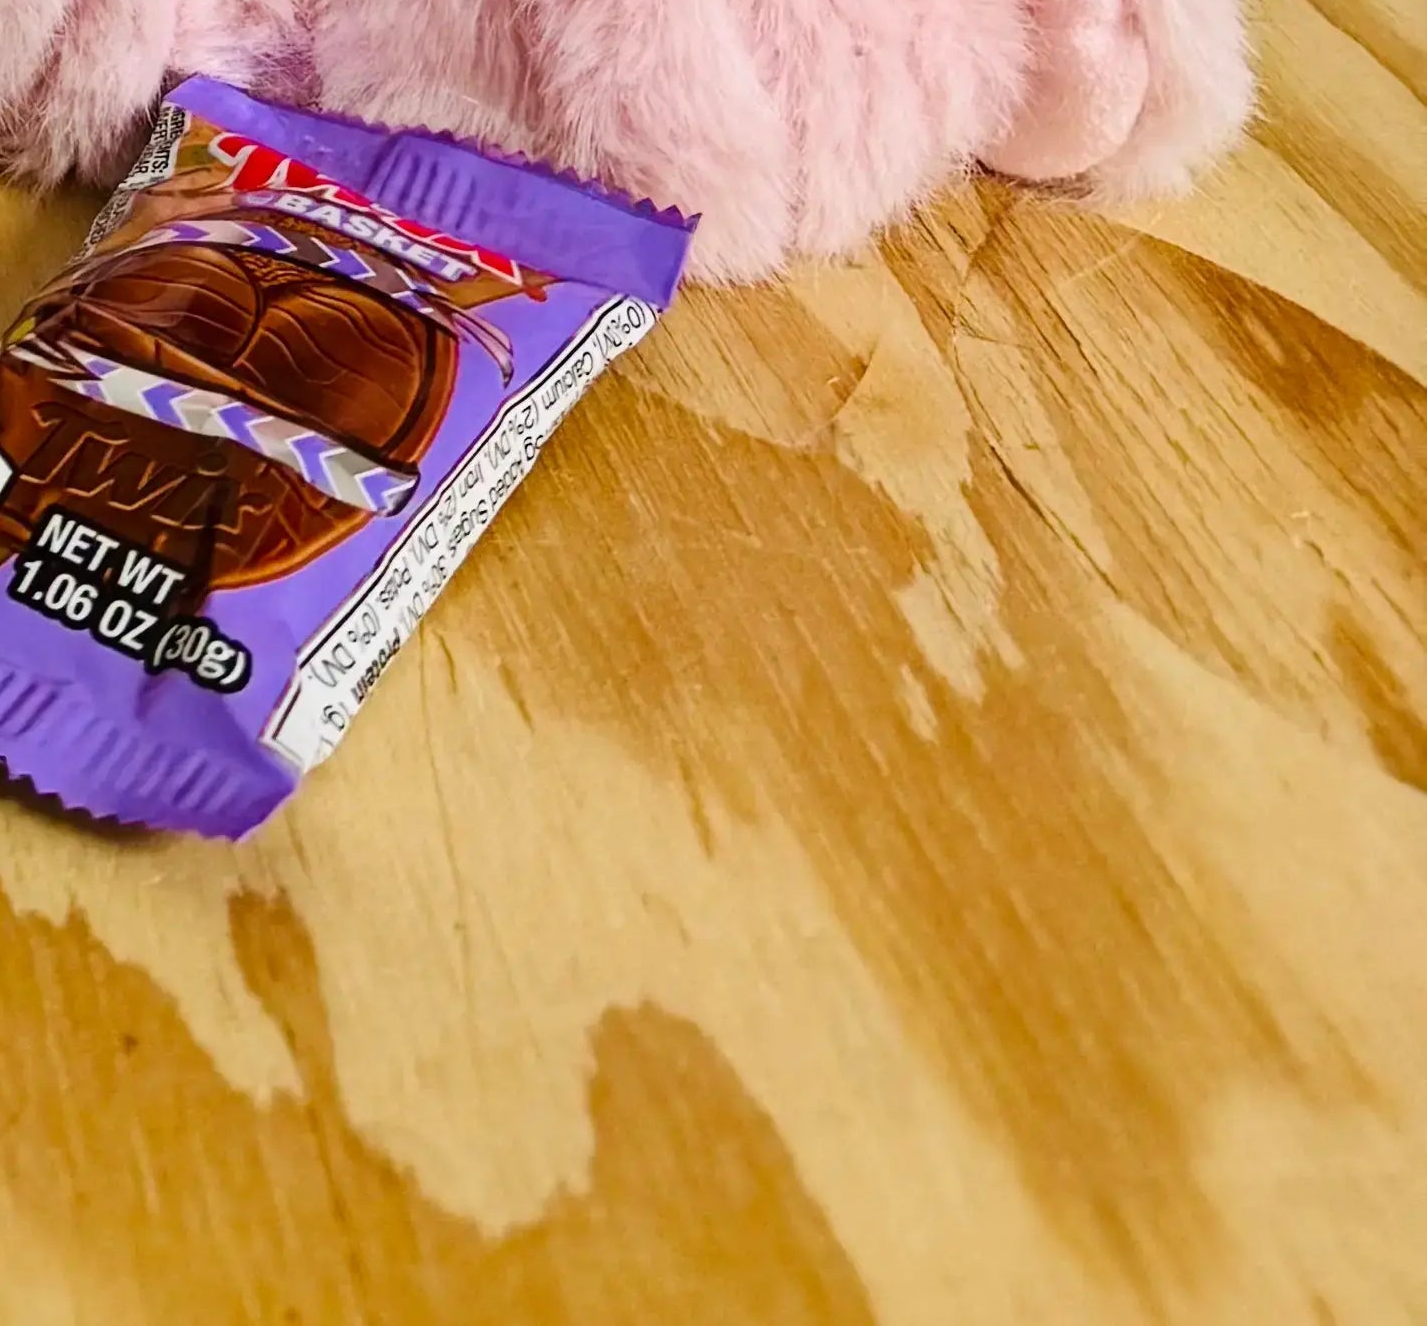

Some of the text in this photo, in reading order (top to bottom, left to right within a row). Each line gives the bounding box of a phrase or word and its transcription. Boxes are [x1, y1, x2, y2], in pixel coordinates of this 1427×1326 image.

[274, 193, 479, 283] BASKET
[38, 513, 186, 606] NET WT
[15, 559, 247, 686] 1.06 OZ (30g)
